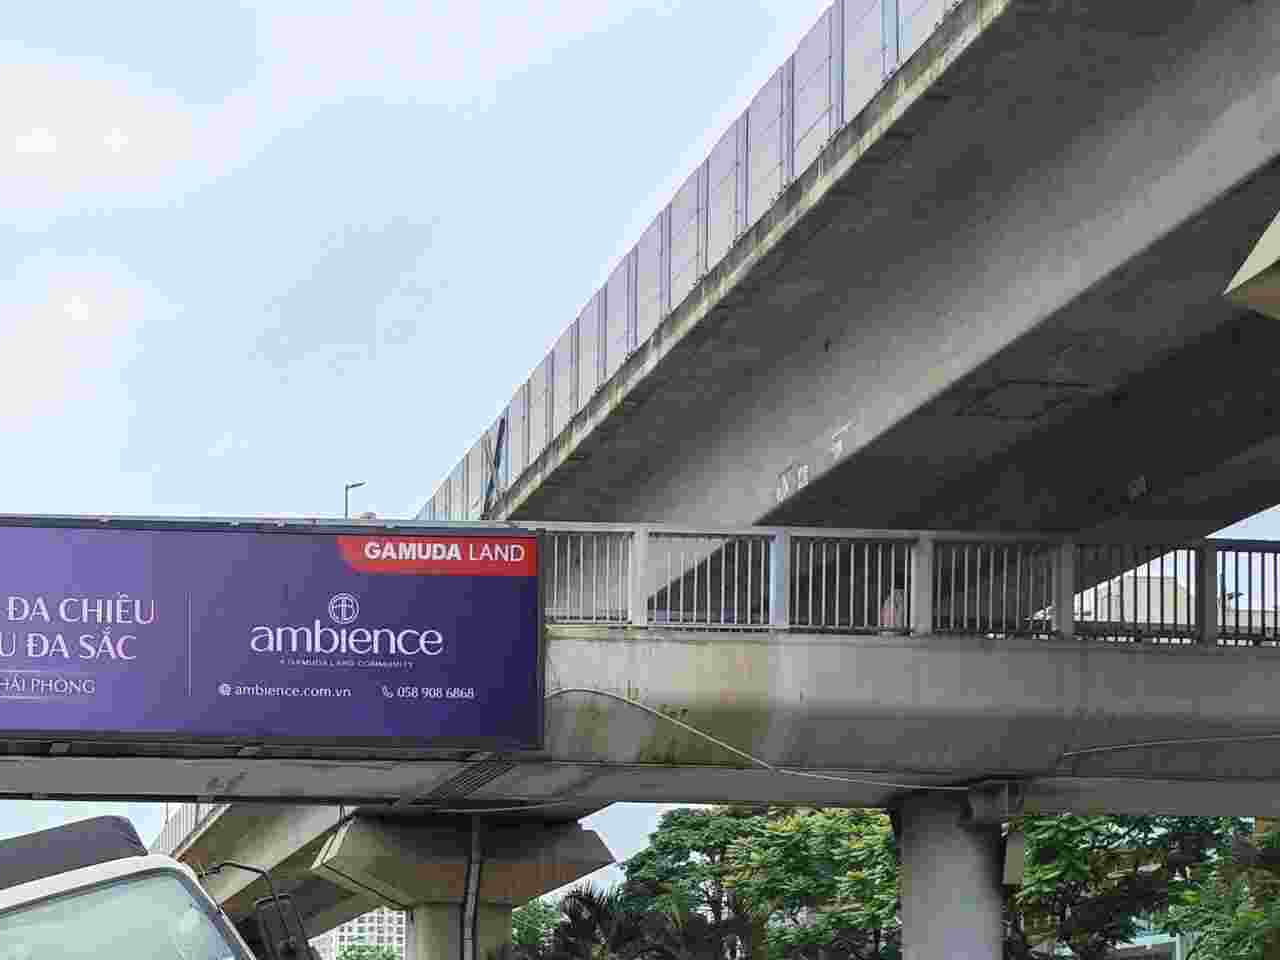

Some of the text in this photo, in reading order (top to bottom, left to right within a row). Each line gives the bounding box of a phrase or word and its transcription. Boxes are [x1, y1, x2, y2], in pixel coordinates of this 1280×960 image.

[364, 542, 525, 562] GAMUDA LAND
[6, 596, 50, 622] ĐA
[26, 632, 69, 659] ĐA
[250, 619, 443, 655] ambience
[235, 684, 353, 698] ambience.com.vn
